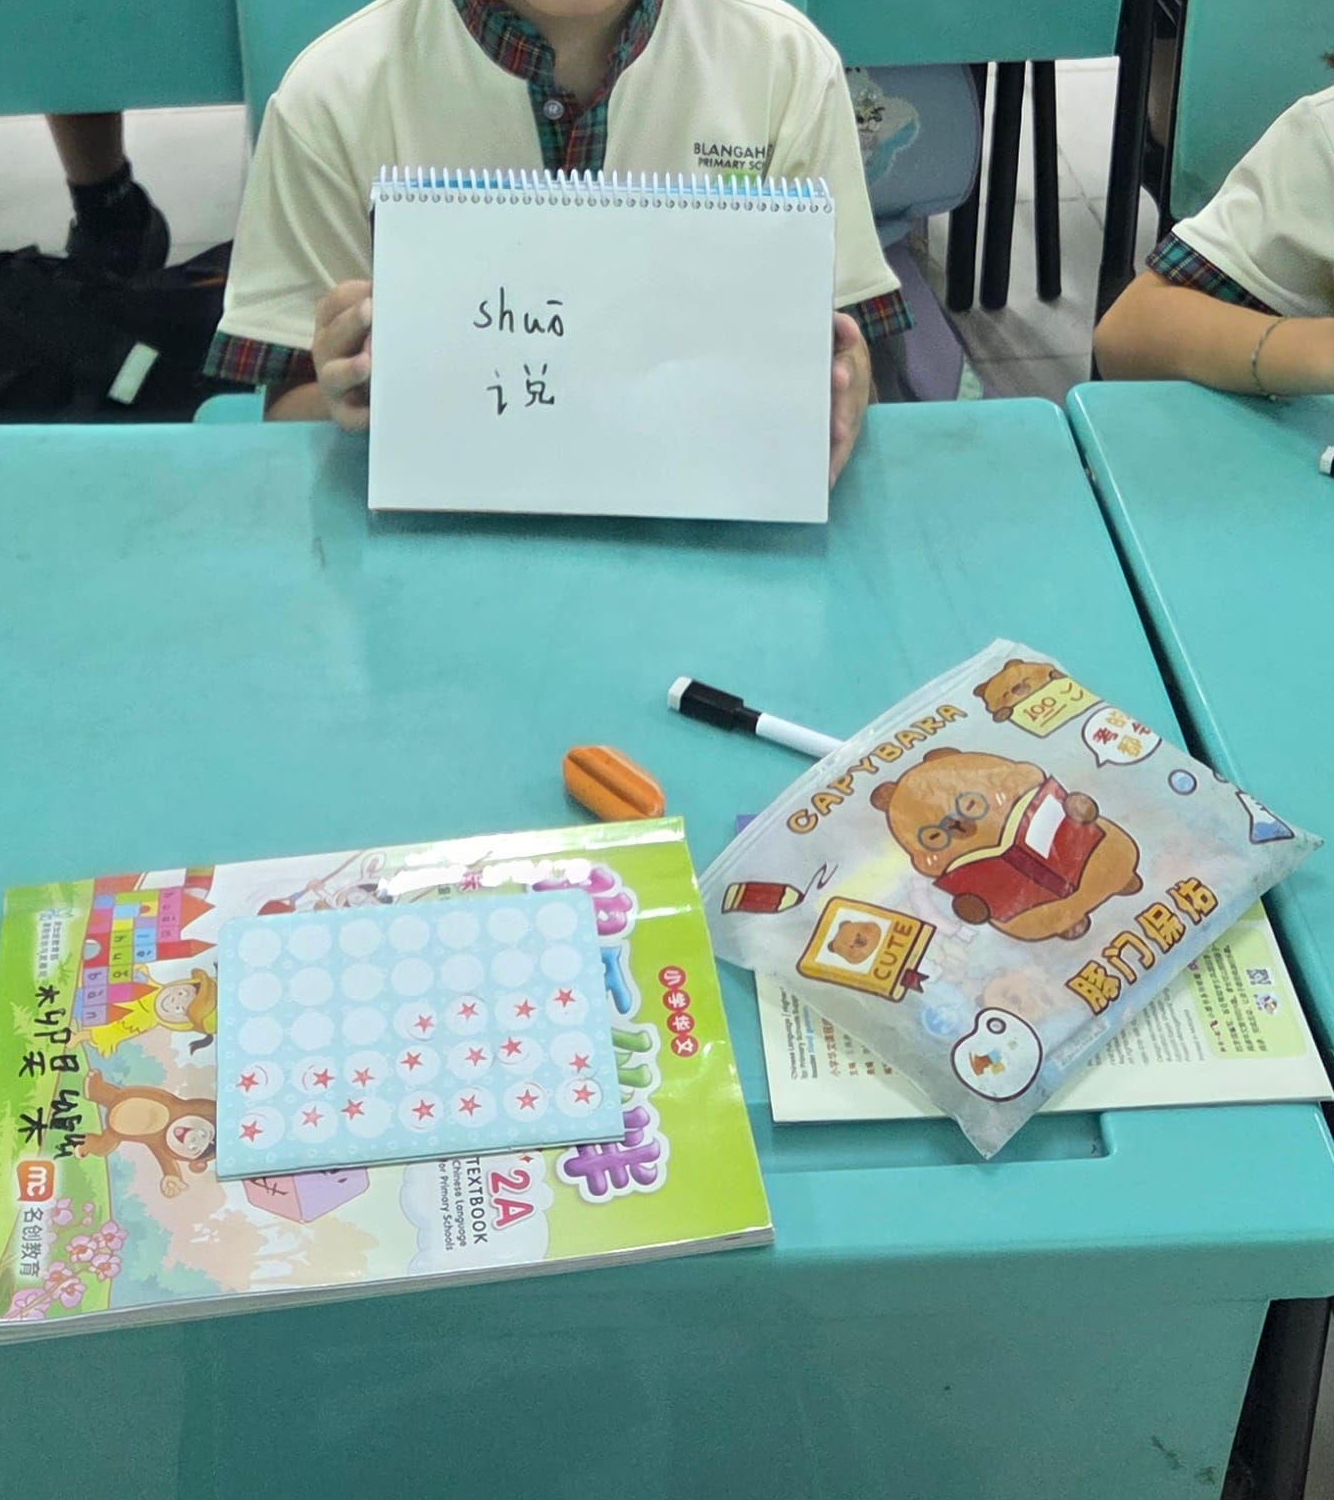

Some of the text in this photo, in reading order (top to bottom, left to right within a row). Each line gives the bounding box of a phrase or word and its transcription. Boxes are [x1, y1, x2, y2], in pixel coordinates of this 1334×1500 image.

[693, 142, 766, 159] BLANGAH
[698, 157, 746, 170] PRIMARY
[473, 286, 564, 337] shuō
[487, 363, 555, 416] 说
[1023, 696, 1057, 722] 100
[787, 705, 968, 834] CAPYBARA
[872, 919, 915, 981] CUTE
[1065, 876, 1219, 1016] 豚门保佑
[86, 972, 104, 1020] bàn
[658, 965, 699, 1058] 小学华文
[27, 1166, 47, 1197] mc
[440, 1175, 450, 1212] Primary
[452, 1159, 467, 1248] Chinese Language
[466, 1156, 489, 1245] TEXTBOOK
[490, 1169, 535, 1228] 2A
[19, 1207, 44, 1279] 名创教育
[443, 1214, 456, 1251] Schools
